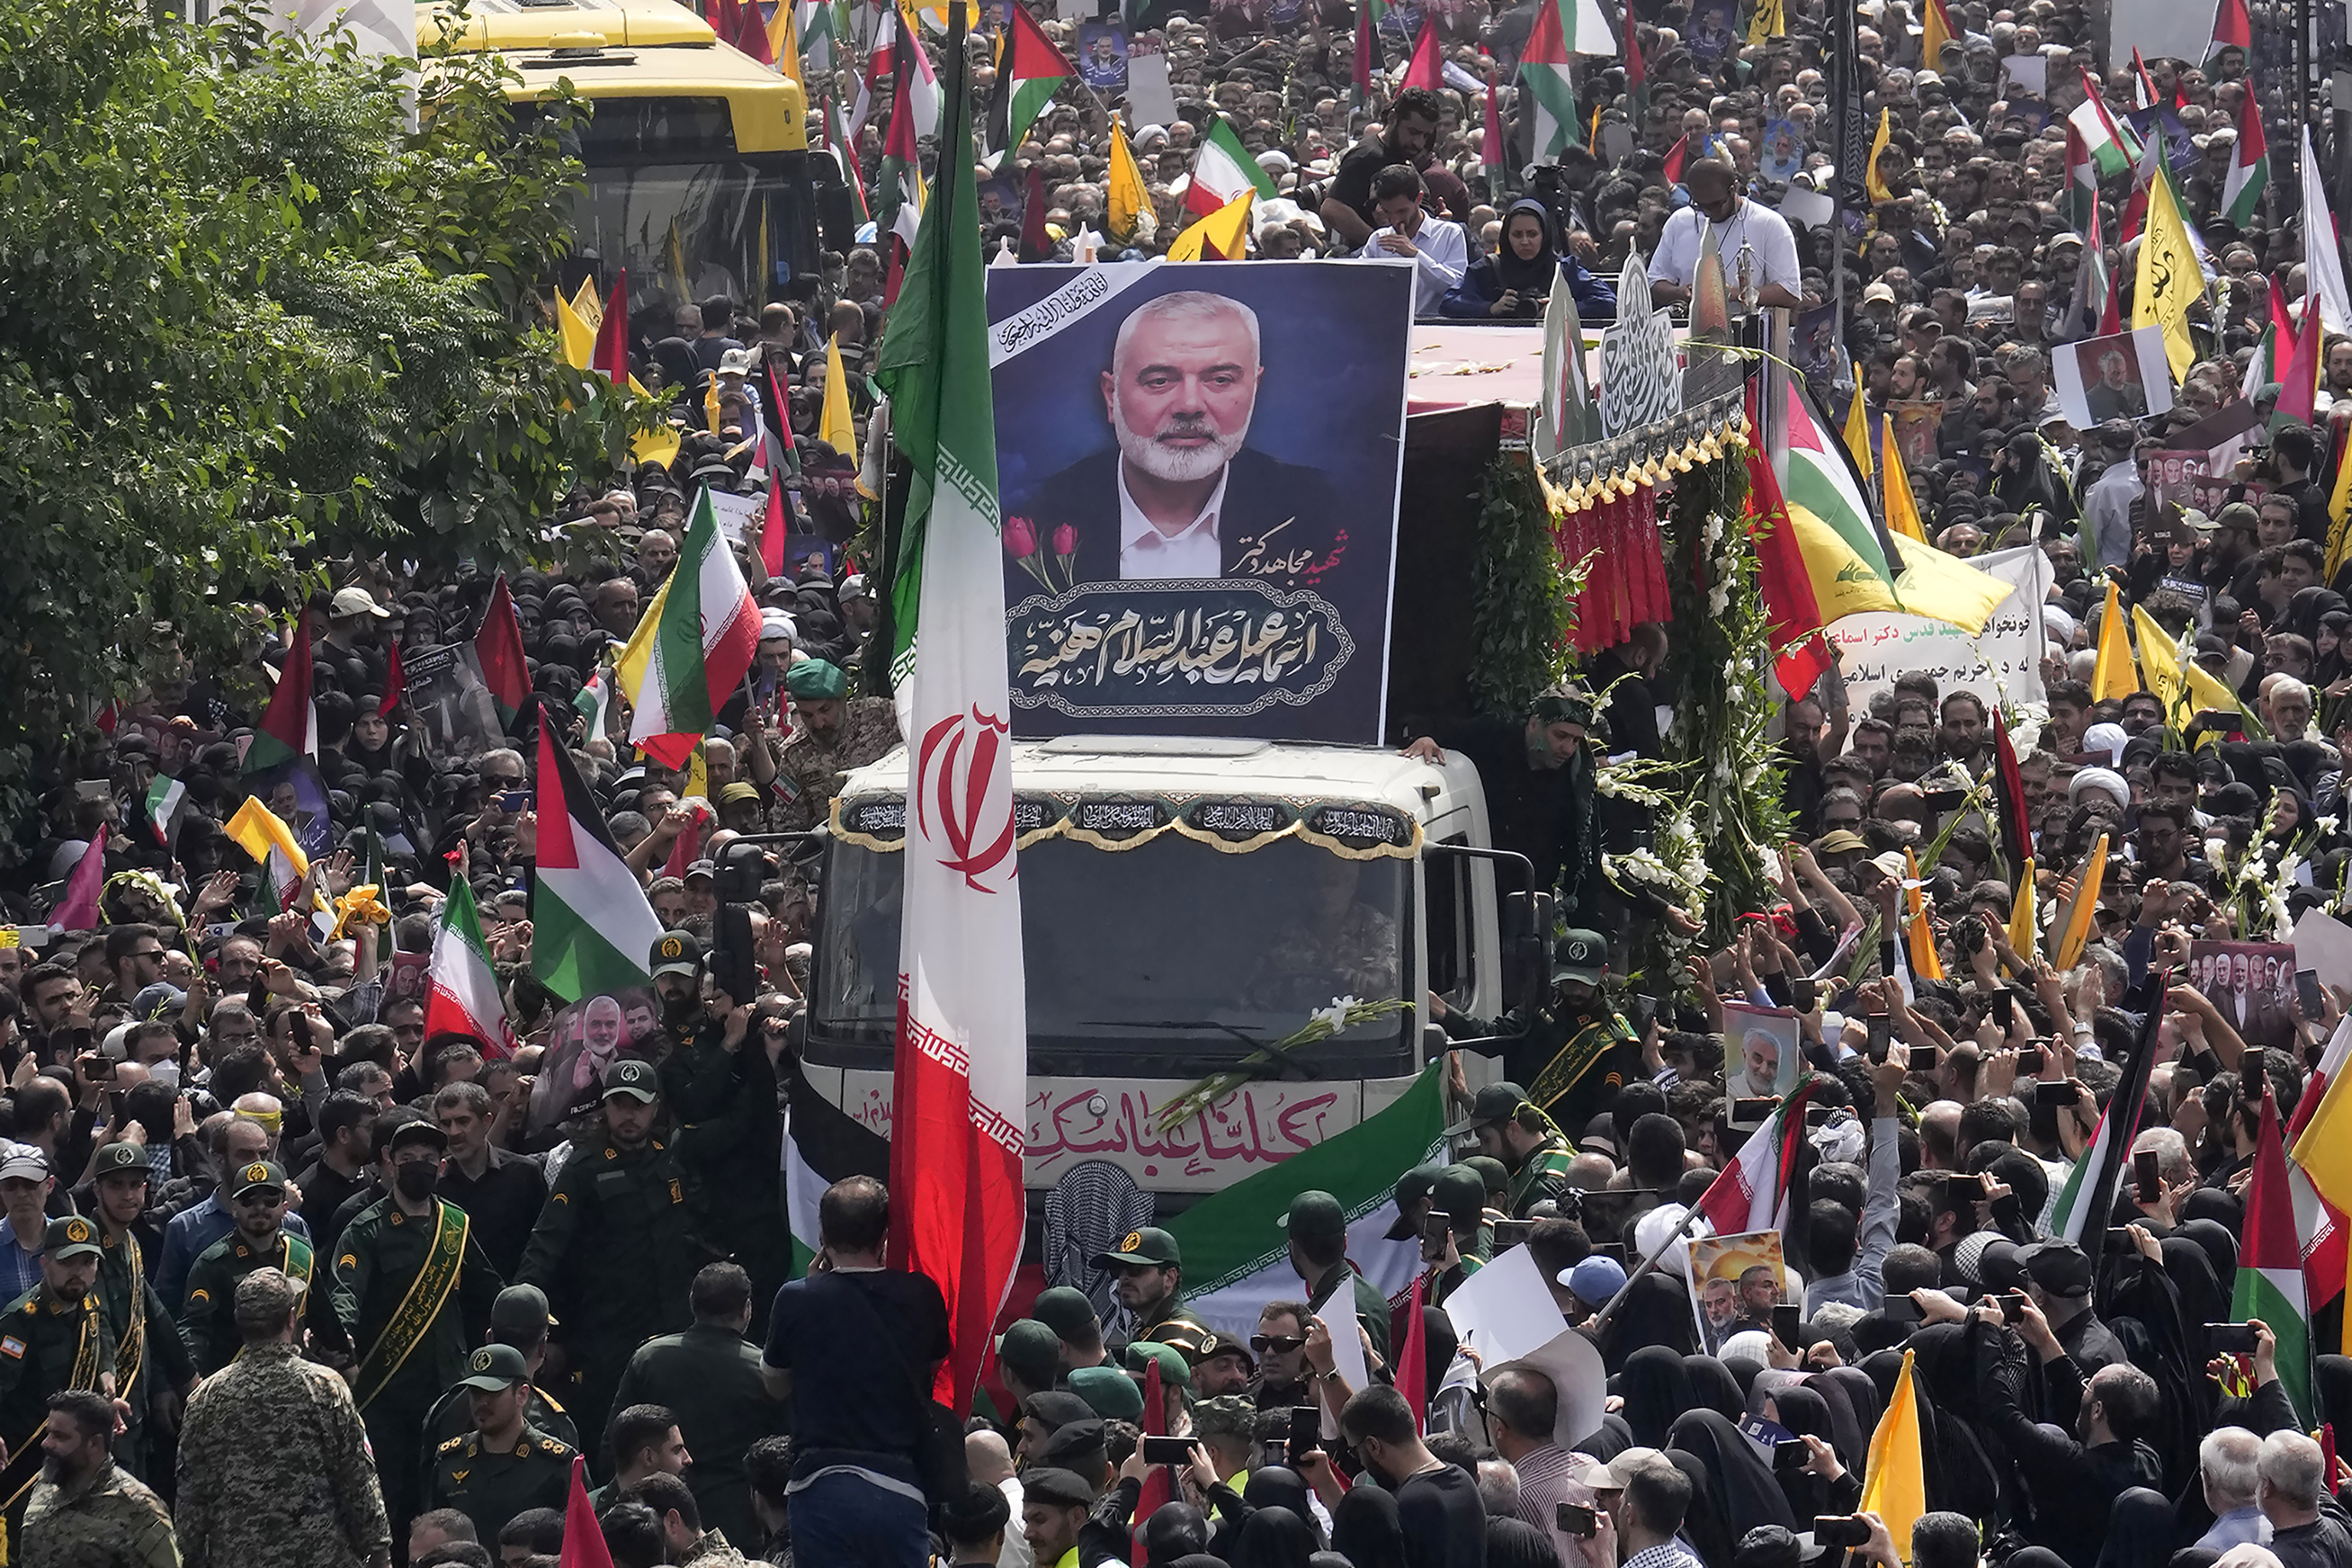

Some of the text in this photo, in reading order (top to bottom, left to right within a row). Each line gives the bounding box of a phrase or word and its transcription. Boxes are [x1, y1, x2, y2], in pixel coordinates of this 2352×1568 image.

[1229, 516, 1349, 586] شهید مجاهد دکتر
[1871, 623, 1900, 647] دکتر
[1903, 619, 1933, 644] قدس
[1937, 626, 1969, 642] هید
[1205, 610, 1318, 684] اسماعیل
[1841, 665, 1885, 688] اسلامی
[1952, 662, 1988, 684] حریم
